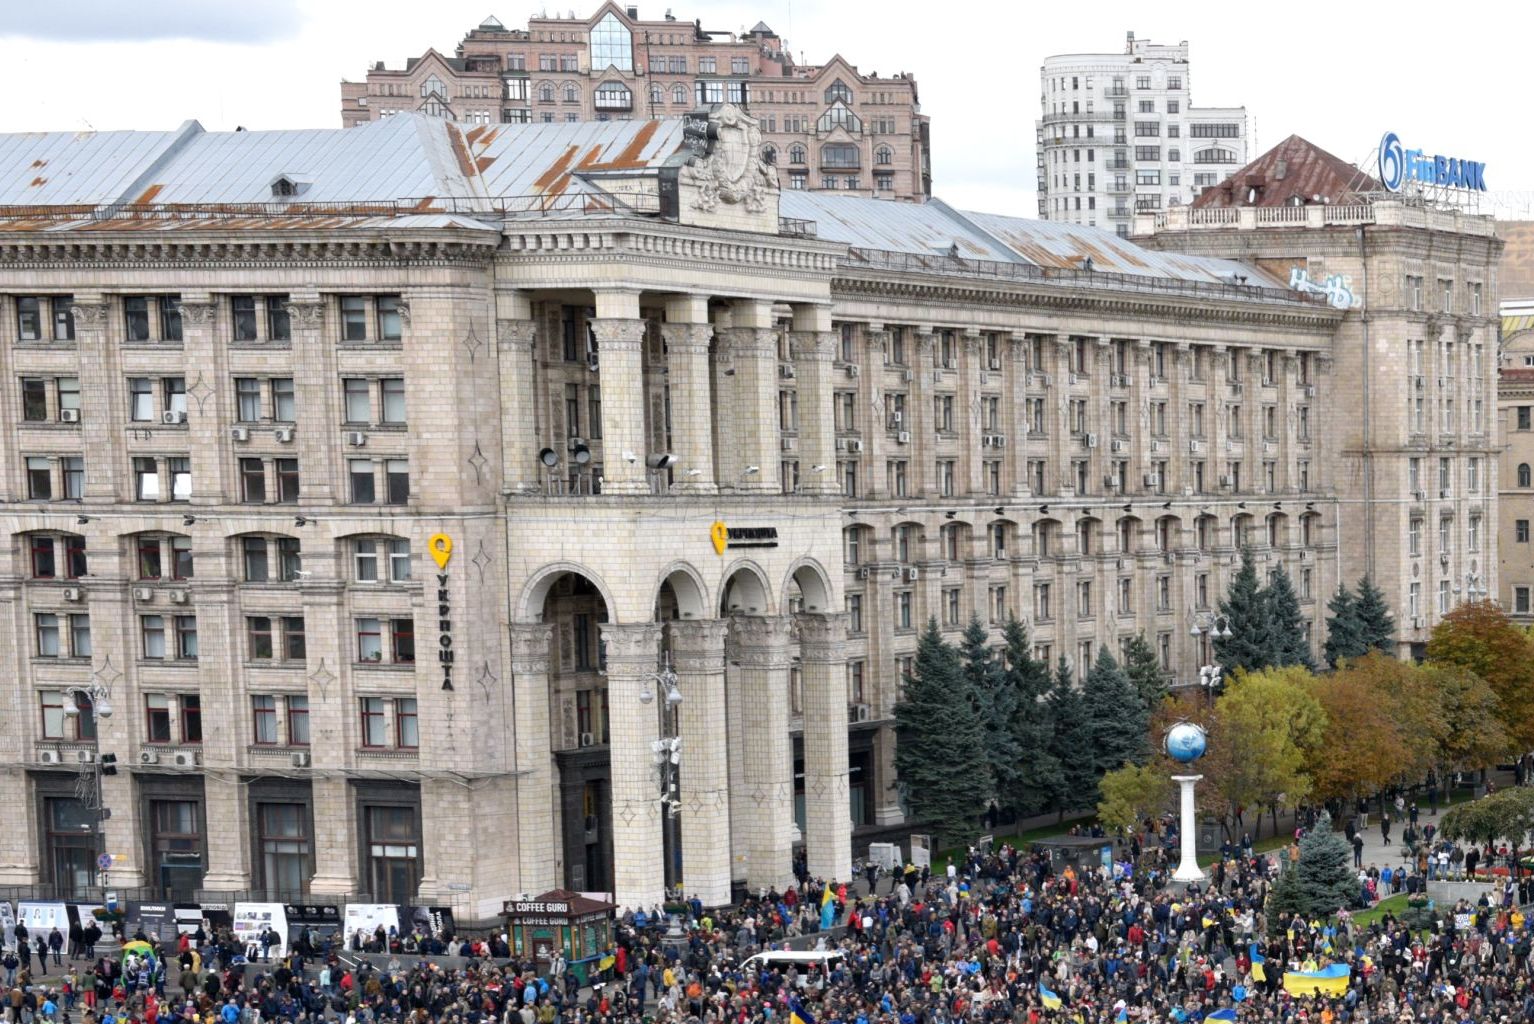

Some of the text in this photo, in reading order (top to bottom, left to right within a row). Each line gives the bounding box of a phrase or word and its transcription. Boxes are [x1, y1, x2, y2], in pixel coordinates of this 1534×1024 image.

[1406, 149, 1487, 192] FinBANK
[437, 574, 454, 691] УКРПОШТА
[516, 902, 568, 912] COFFEE GURU
